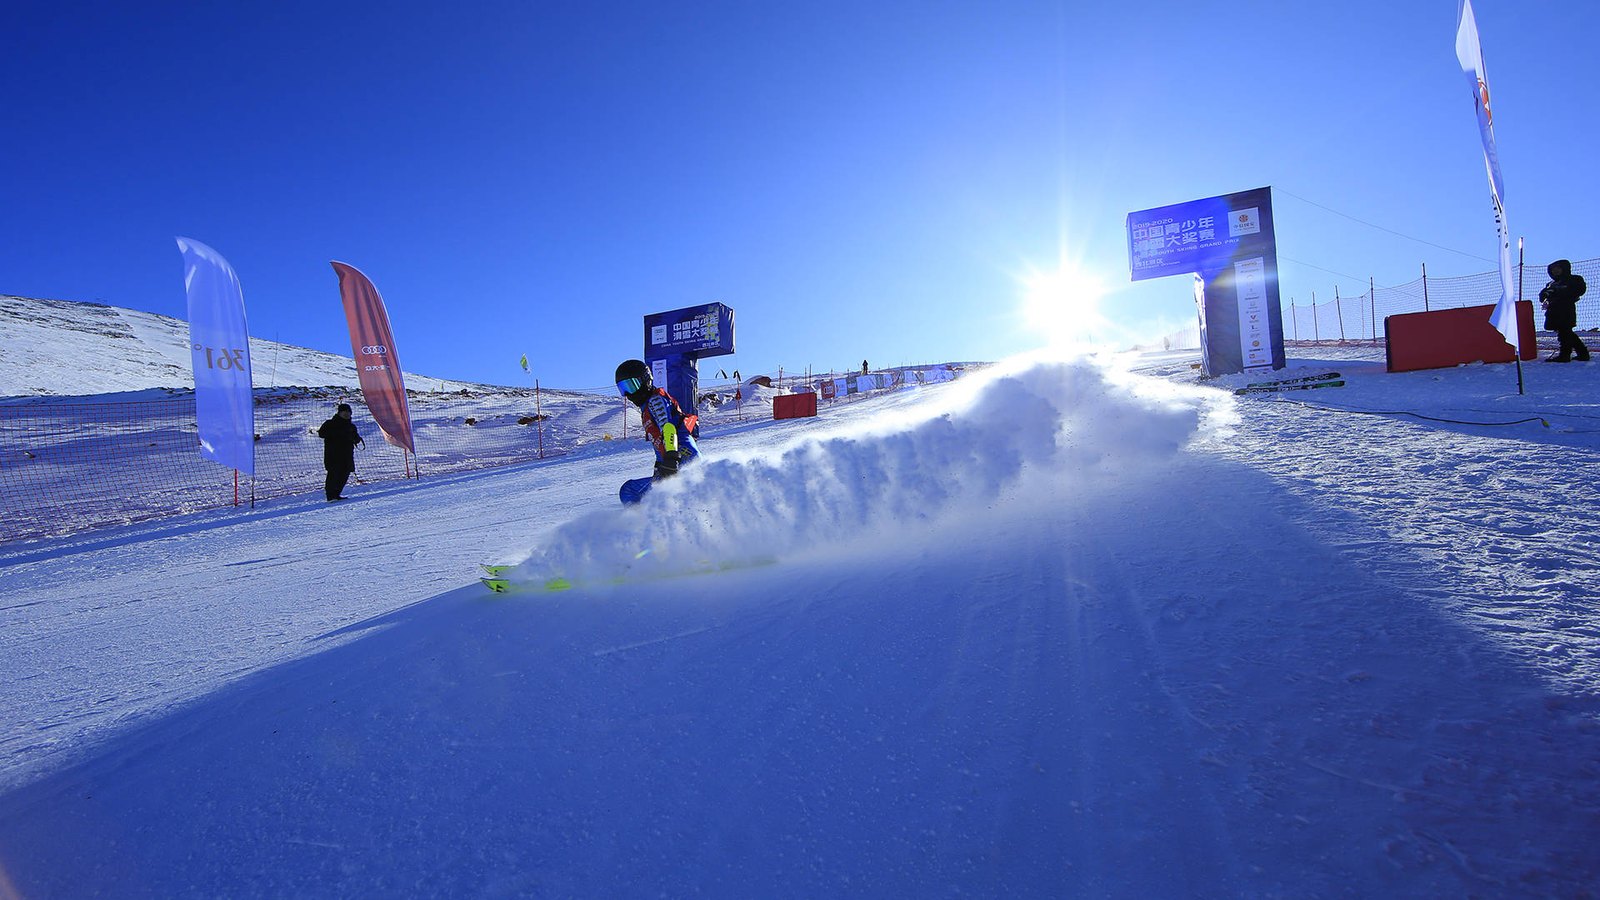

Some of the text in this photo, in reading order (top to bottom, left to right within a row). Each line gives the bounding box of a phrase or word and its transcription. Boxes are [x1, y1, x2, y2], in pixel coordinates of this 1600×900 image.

[1133, 216, 1214, 240] 中国青少年
